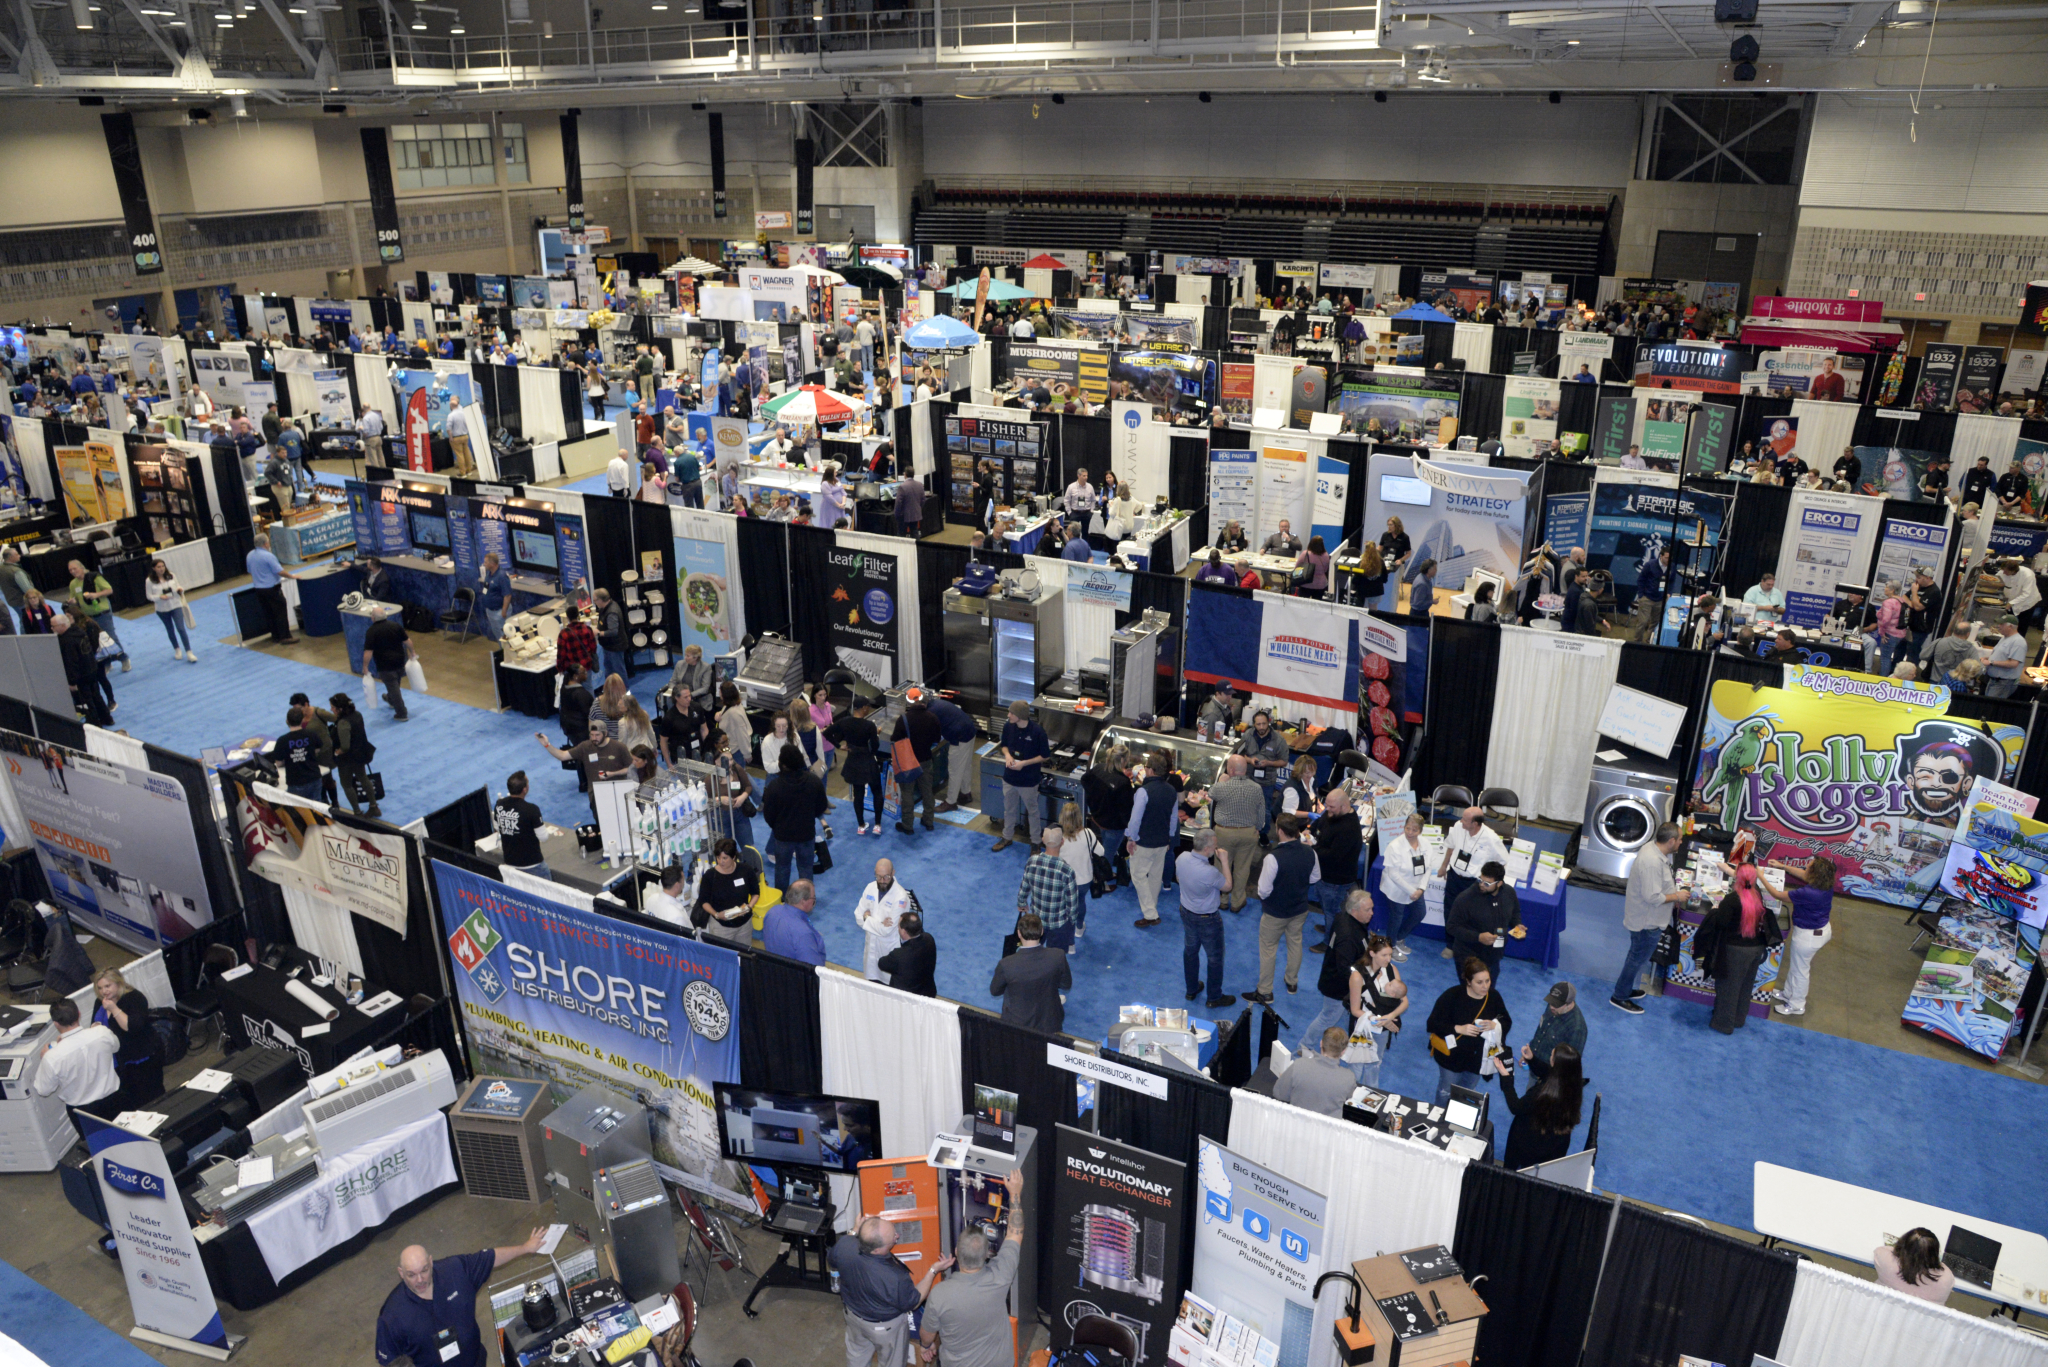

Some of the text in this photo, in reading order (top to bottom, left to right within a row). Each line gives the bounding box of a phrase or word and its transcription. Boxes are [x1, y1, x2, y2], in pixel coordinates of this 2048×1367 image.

[570, 204, 584, 213] 600
[798, 209, 813, 217] 800
[133, 234, 155, 246] 400
[379, 230, 399, 241] 500
[763, 276, 795, 286] WAGNER
[1575, 336, 1608, 345] LANDMARK
[1010, 347, 1079, 361] MUSHROOMS
[1929, 352, 1955, 362] 1932
[1968, 357, 1996, 367] 1932
[1670, 364, 1725, 377] EXCHANGE
[1765, 359, 1812, 370] Essential
[1376, 376, 1421, 387] INK SPLASH
[979, 420, 1025, 436] FISHER
[980, 432, 1025, 441] ARCHITECTURE
[1640, 448, 1681, 460] UniFirst
[1422, 466, 1497, 495] ENERNOVA
[381, 487, 432, 508] ARK SYSTEMS
[1446, 492, 1512, 511] STRATEGY
[482, 503, 540, 527] ARK SYSTEMS
[1455, 507, 1470, 515] today
[1493, 511, 1509, 519] future
[1805, 511, 1842, 524] ERCO
[317, 523, 341, 535] CRAFT
[1889, 523, 1928, 538] ERCO
[302, 534, 329, 547] SAUCE
[829, 551, 893, 573] Leaf Filter
[1085, 582, 1113, 592] REQUIP
[1801, 596, 1826, 605] 200,000
[834, 623, 884, 640] Our Revolutionary
[1270, 642, 1311, 658] WHOLESALE
[1314, 647, 1338, 662] MEATS
[1616, 692, 1675, 719] Ask about our
[289, 737, 309, 749] POS
[1762, 735, 1895, 788] Jolly
[147, 777, 176, 791] MASTER
[150, 784, 181, 801] BUILDERS
[14, 779, 120, 824] What's Under Your Feet?
[1748, 773, 1910, 831] Roger
[1981, 786, 2026, 809] Dean the
[1983, 795, 2017, 813] Dream
[496, 806, 519, 818] Soda
[54, 816, 64, 827] for
[64, 820, 85, 837] Every
[86, 828, 122, 849] Challenge
[1761, 830, 1801, 847] Ocean
[1829, 843, 1893, 863] Maryland
[327, 841, 398, 877] MARYLAND
[1975, 863, 2000, 878] OCEAN
[314, 884, 331, 895] Canon
[348, 897, 396, 922] www.md-copier.com
[491, 890, 501, 900] BIG
[503, 895, 527, 909] ENOUGH
[528, 904, 536, 912] TO
[537, 908, 557, 919] SERVE
[573, 918, 594, 931] SMALL
[595, 926, 622, 939] ENOUGH
[623, 933, 632, 941] TO
[633, 936, 653, 948] KNOW
[458, 888, 713, 979] PRODUCTS SERVICES SOLUTIONS
[506, 942, 668, 1028] SHORE
[512, 977, 673, 1045] DISTRIBUTORS, INC.
[693, 1000, 720, 1024] 1946
[464, 1001, 630, 1072] PLUMBING, HEATING & AIR
[1064, 1054, 1150, 1088] SHORE DISTRIBUTORS, INC.
[107, 1163, 160, 1191] First Co.
[334, 1149, 408, 1198] SHORE
[1067, 1156, 1173, 1197] REVOLUTIONARY
[1232, 1162, 1289, 1196] BIG ENOUGH
[1066, 1167, 1172, 1208] HEAT EXCHANGER
[1254, 1184, 1320, 1222] TO SERVE YOU.
[129, 1211, 161, 1228] Leader
[127, 1221, 172, 1241] Innovator
[116, 1229, 191, 1260] Trusted Supplier
[135, 1247, 180, 1267] Since 1966
[1217, 1228, 1308, 1282] Faucets, Water Heaters,
[1239, 1249, 1307, 1292] Plumbing & Parts
[159, 1285, 198, 1301] Manufacturing
[172, 1279, 191, 1290] Quality
